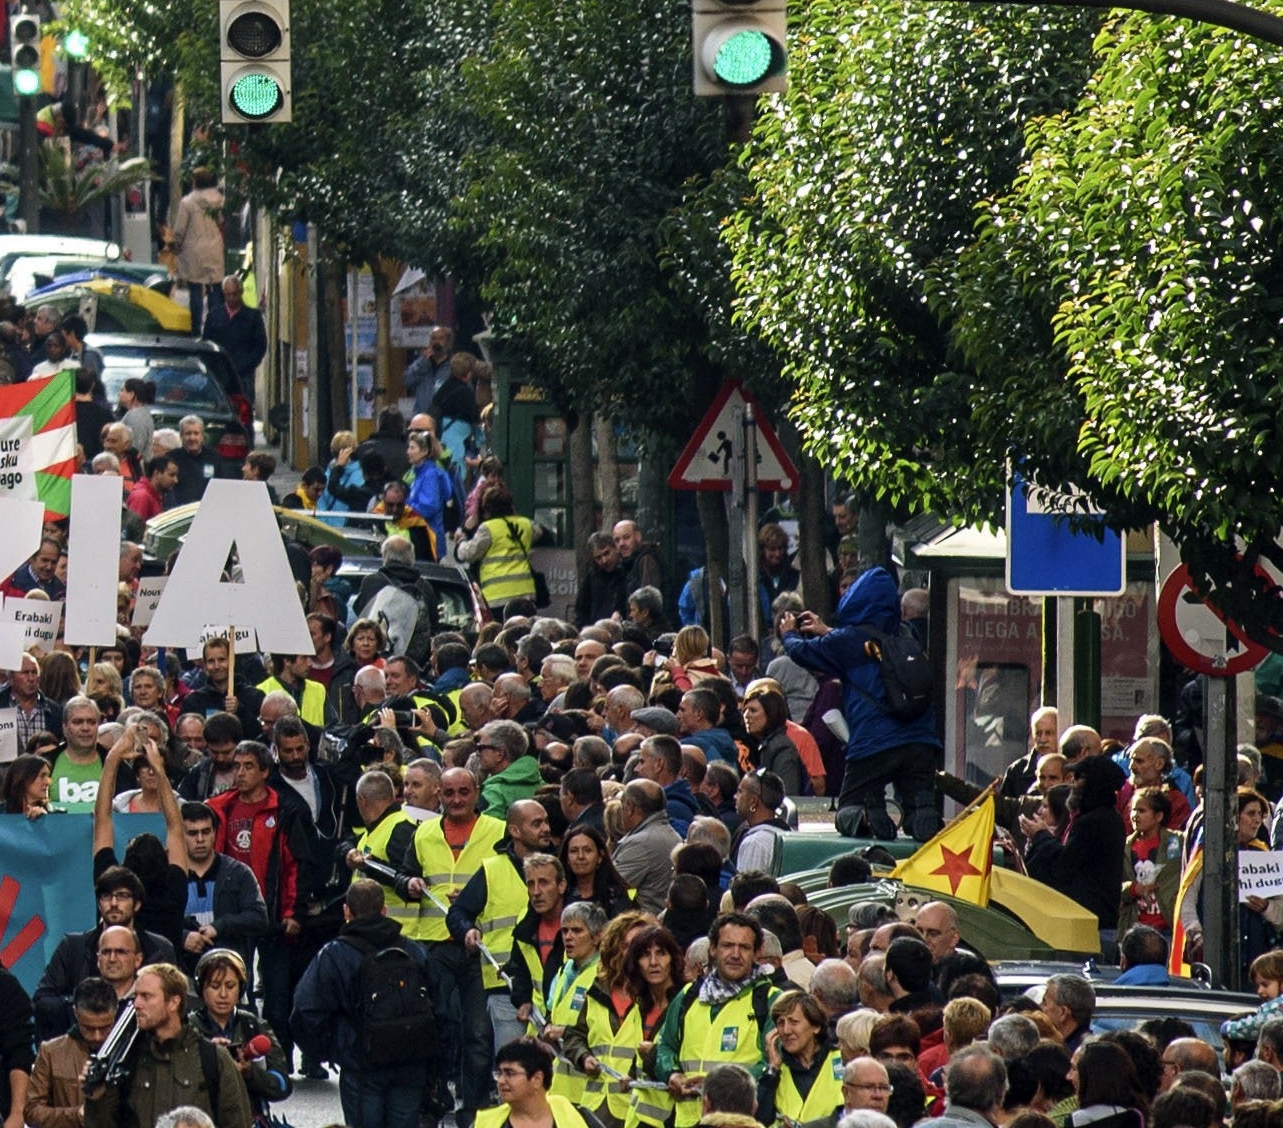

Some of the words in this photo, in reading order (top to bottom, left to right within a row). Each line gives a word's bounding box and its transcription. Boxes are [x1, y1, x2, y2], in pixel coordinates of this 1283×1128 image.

[15, 610, 53, 624] Erabaki
[33, 627, 54, 640] dugu
[965, 623, 1019, 639] LLEGA
[1241, 862, 1280, 874] abaki
